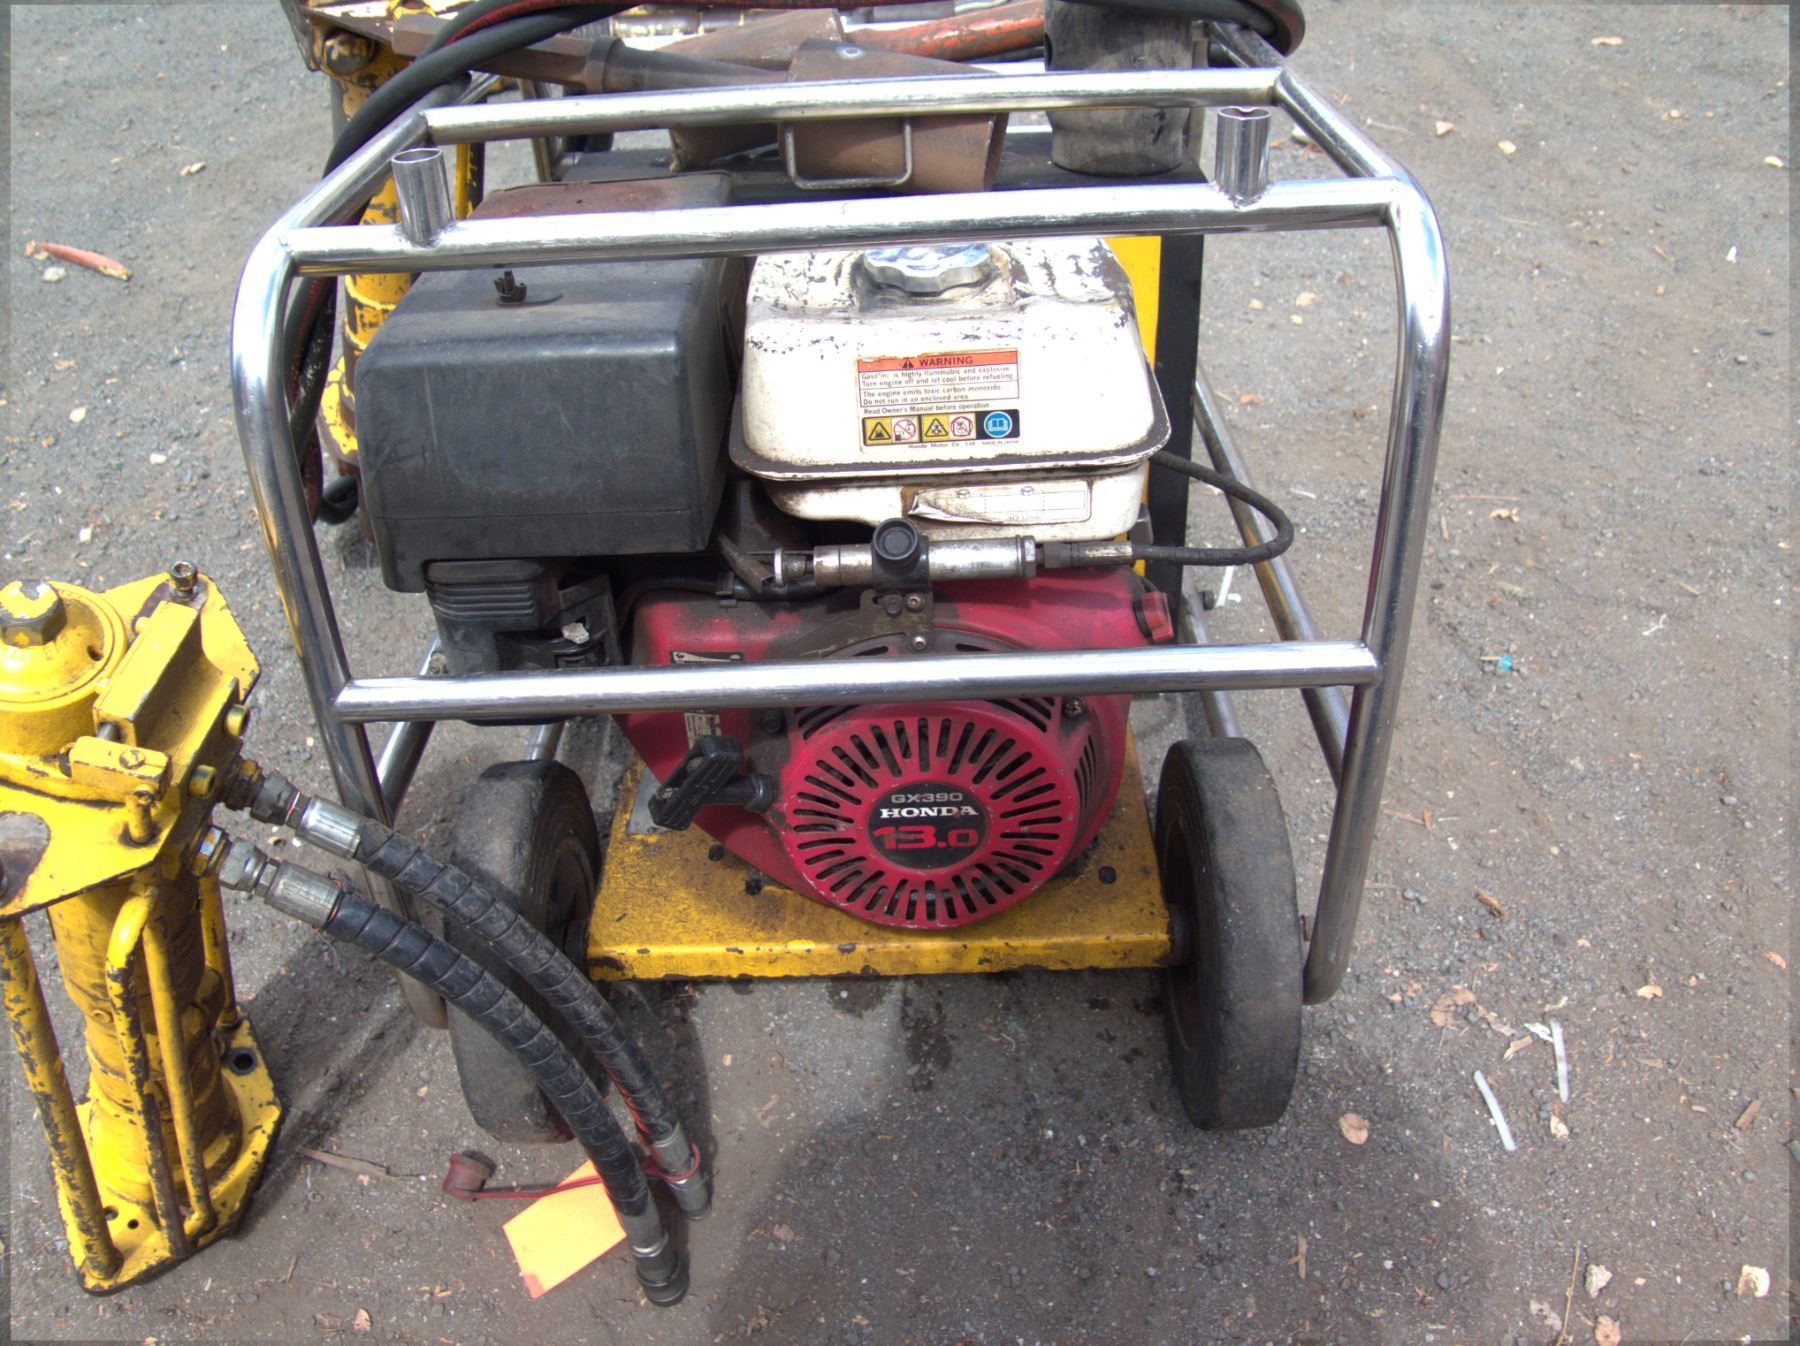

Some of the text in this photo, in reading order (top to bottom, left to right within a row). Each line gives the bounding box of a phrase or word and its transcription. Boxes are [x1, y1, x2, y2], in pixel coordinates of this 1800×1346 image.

[920, 356, 974, 367] WARNING
[901, 370, 922, 378] highly
[880, 380, 903, 388] engine
[878, 390, 901, 398] engine
[921, 394, 951, 402] enclosed
[910, 405, 934, 413] Manual
[959, 402, 992, 411] operation.
[891, 792, 964, 804] GX390
[880, 805, 979, 819] HONDA
[872, 824, 979, 850] 13.0
